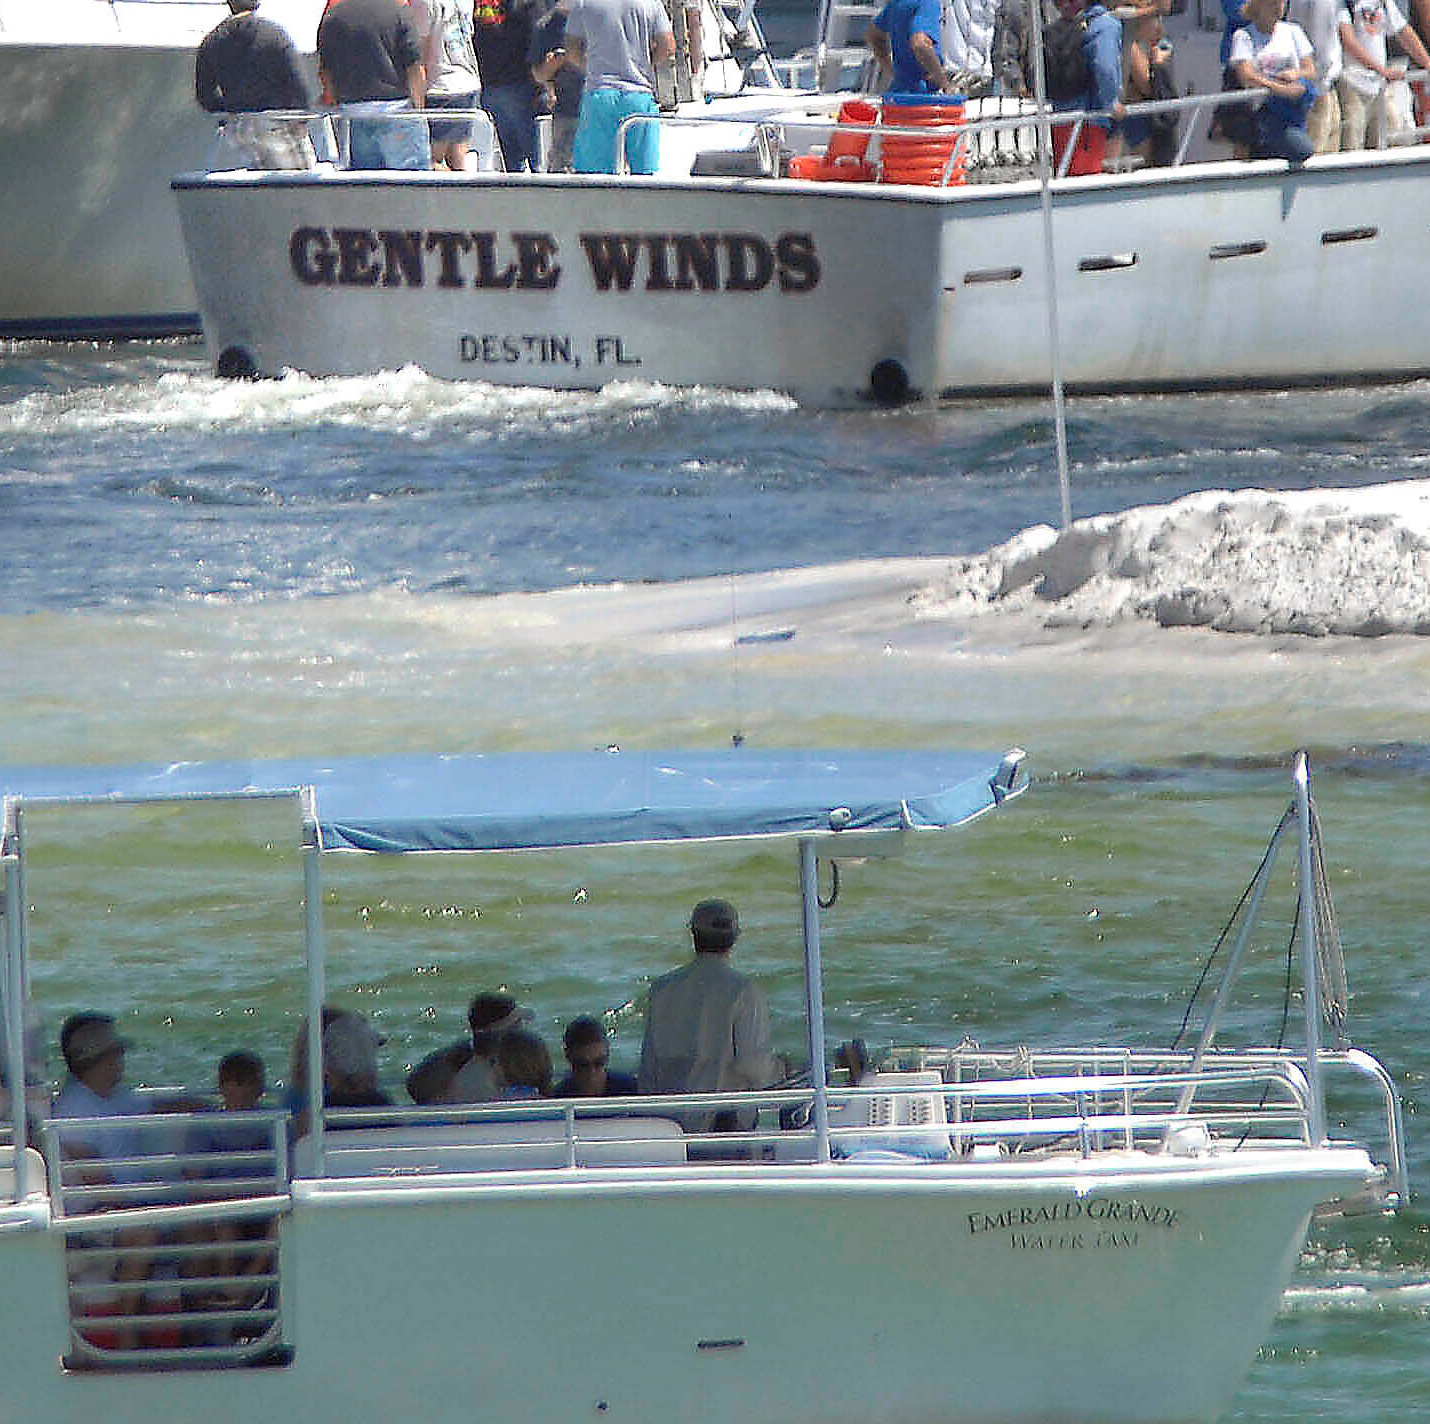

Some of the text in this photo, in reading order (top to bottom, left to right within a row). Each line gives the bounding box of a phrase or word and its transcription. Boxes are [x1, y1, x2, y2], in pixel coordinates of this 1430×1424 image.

[289, 226, 823, 293] GENTLE WINDS
[459, 335, 644, 368] DESTIN, FL.
[967, 1196, 1180, 1235] EMERALD GRANDE
